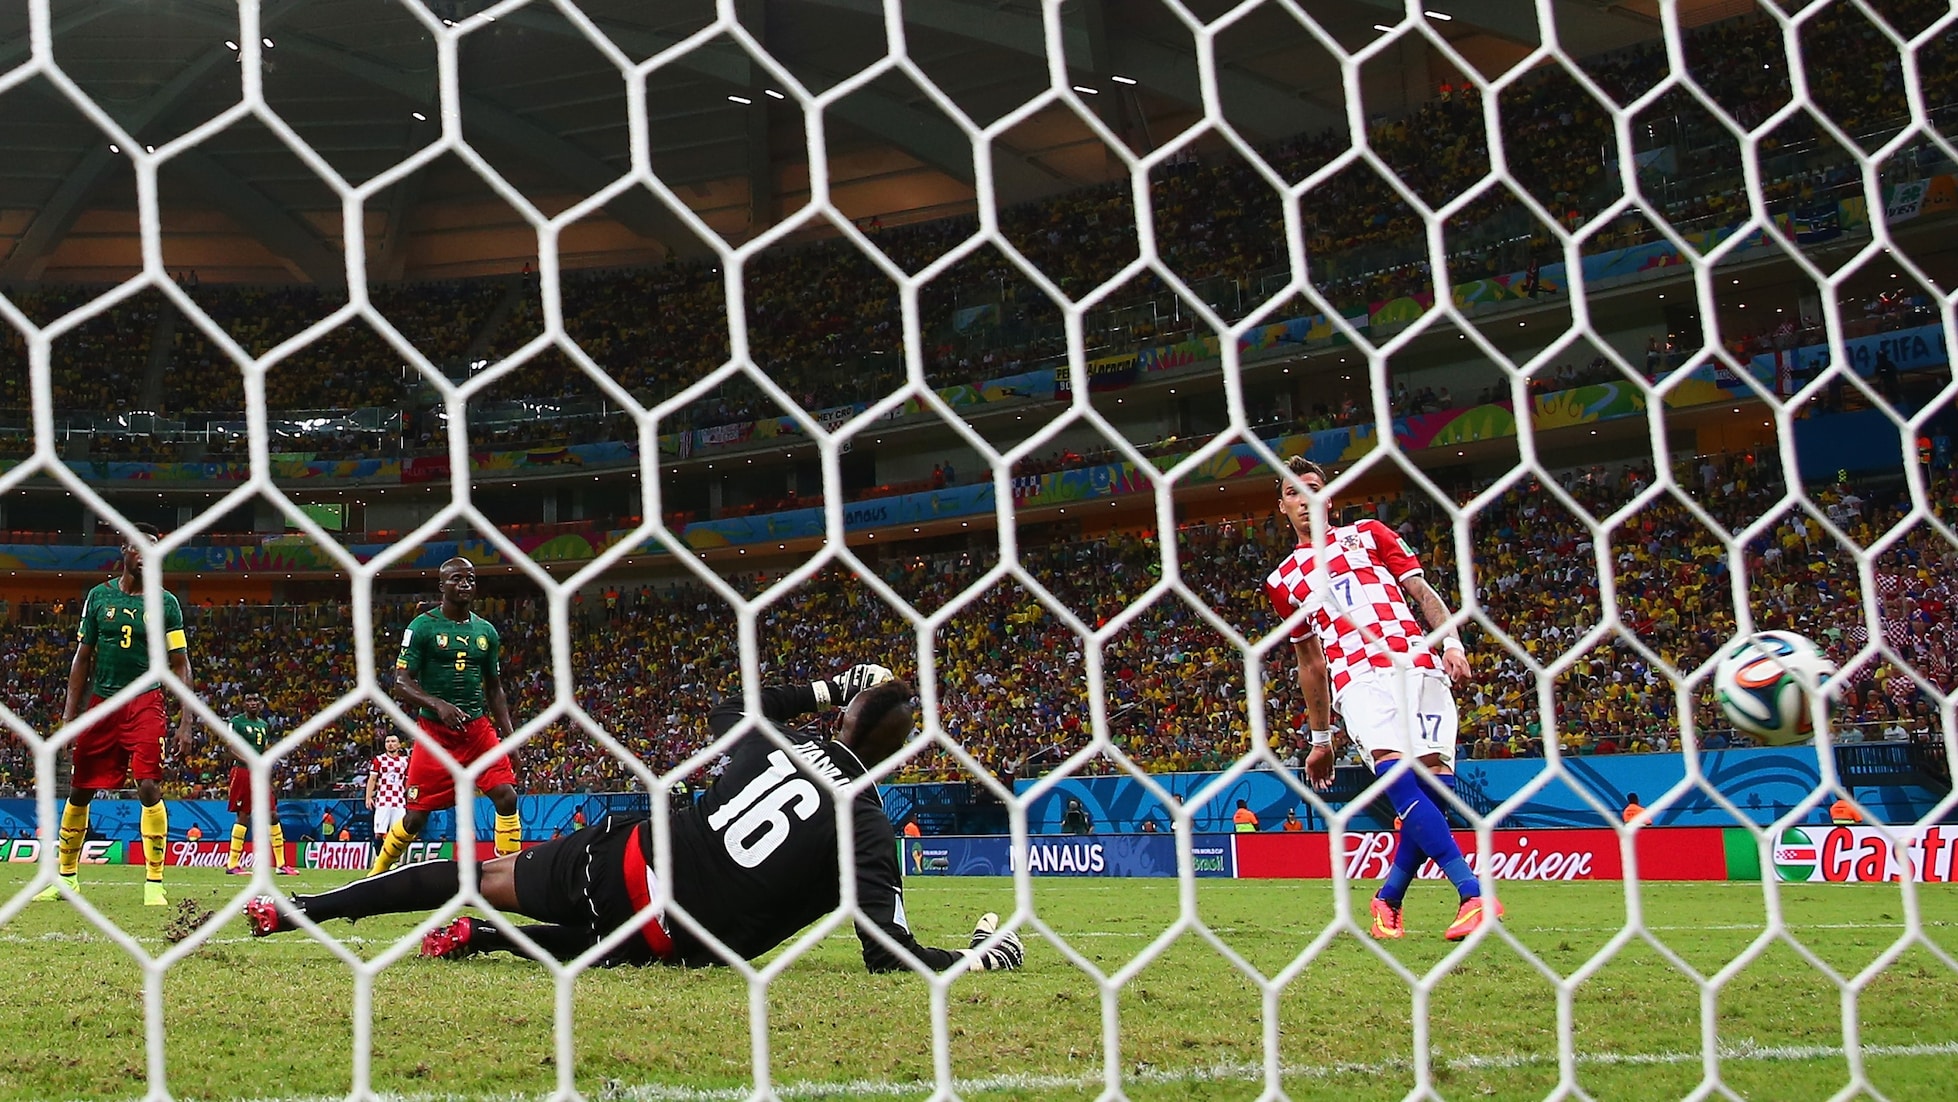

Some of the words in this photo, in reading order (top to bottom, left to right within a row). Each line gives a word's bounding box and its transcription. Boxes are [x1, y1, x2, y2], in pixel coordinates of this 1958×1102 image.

[1880, 336, 1930, 361] FIFA
[843, 506, 887, 525] anaus
[1333, 577, 1355, 607] 7
[120, 625, 132, 648] 3
[455, 651, 466, 671] 5
[1416, 711, 1443, 743] 17
[159, 736, 166, 760] 3
[390, 774, 397, 784] 3
[707, 749, 820, 868] 16
[318, 841, 367, 869] Castrol
[1010, 844, 1105, 872] ANAUS
[1342, 831, 1593, 880] Beiser
[1822, 826, 1958, 882] Cast
